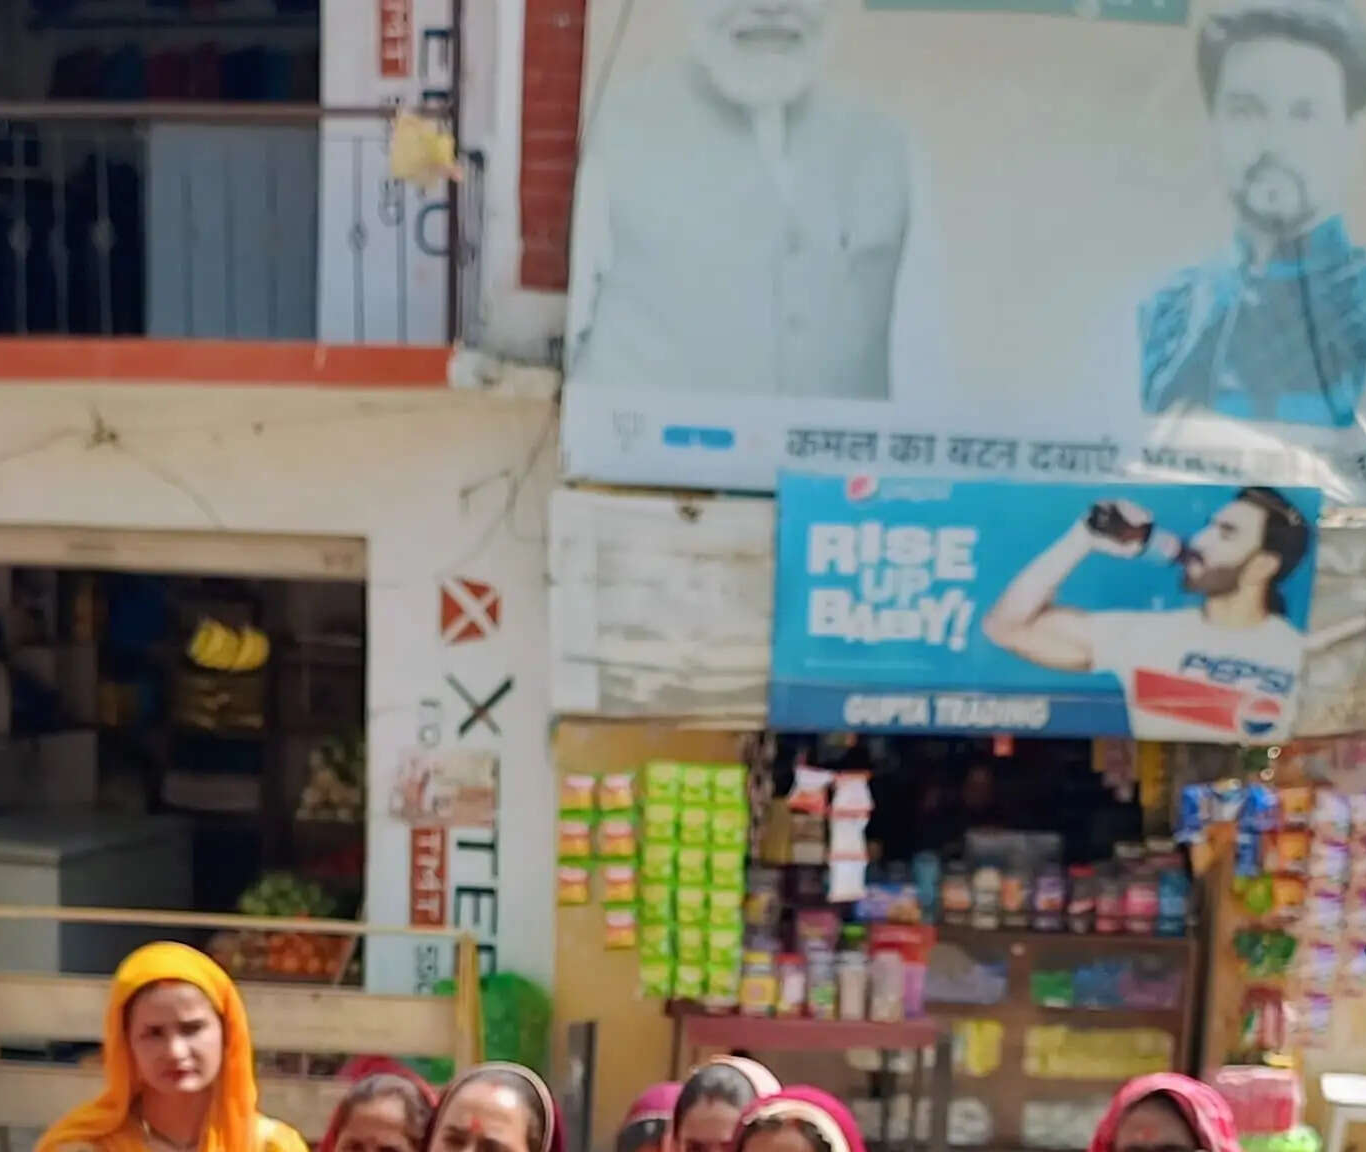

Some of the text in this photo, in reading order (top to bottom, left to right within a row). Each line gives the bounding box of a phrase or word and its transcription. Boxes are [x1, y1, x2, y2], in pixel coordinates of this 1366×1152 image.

[786, 428, 879, 462] कमल
[888, 432, 938, 466] का
[946, 436, 1020, 470] बटन
[807, 520, 979, 581] RISE
[860, 567, 931, 609] UP
[807, 587, 976, 652] BABY!
[1178, 651, 1295, 698] PEPSI
[844, 693, 1050, 730] GUPTA TRADING
